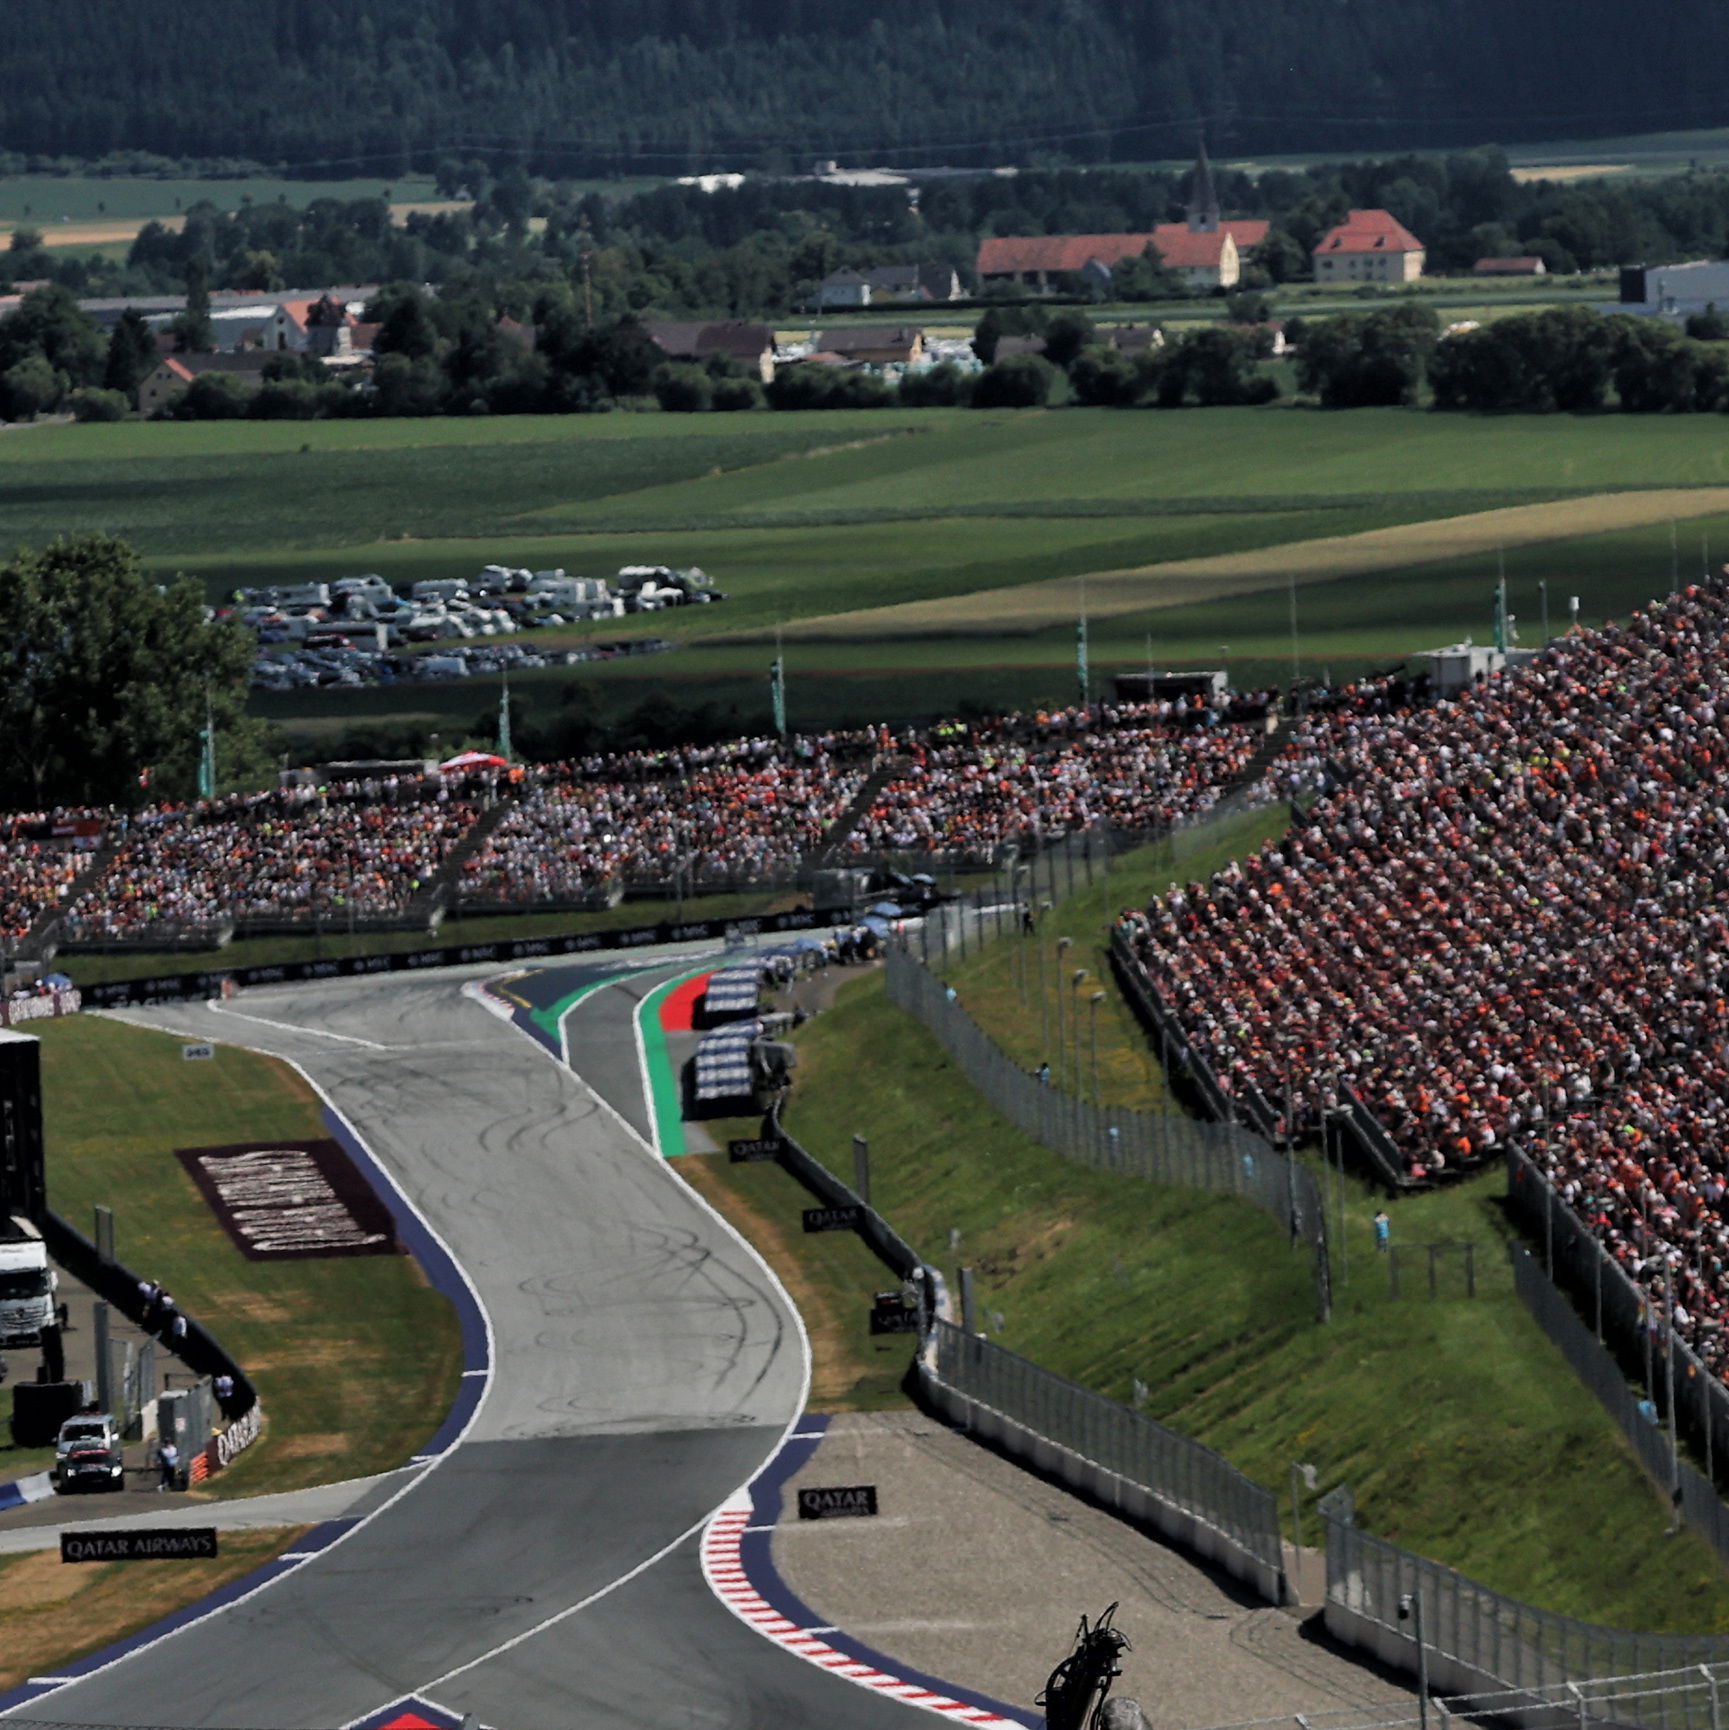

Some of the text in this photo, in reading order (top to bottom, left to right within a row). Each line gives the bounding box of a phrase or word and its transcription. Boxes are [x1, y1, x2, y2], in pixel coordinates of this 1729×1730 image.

[803, 1490, 869, 1511] QATAR
[66, 1535, 213, 1559] QATAR AIRWAYS
